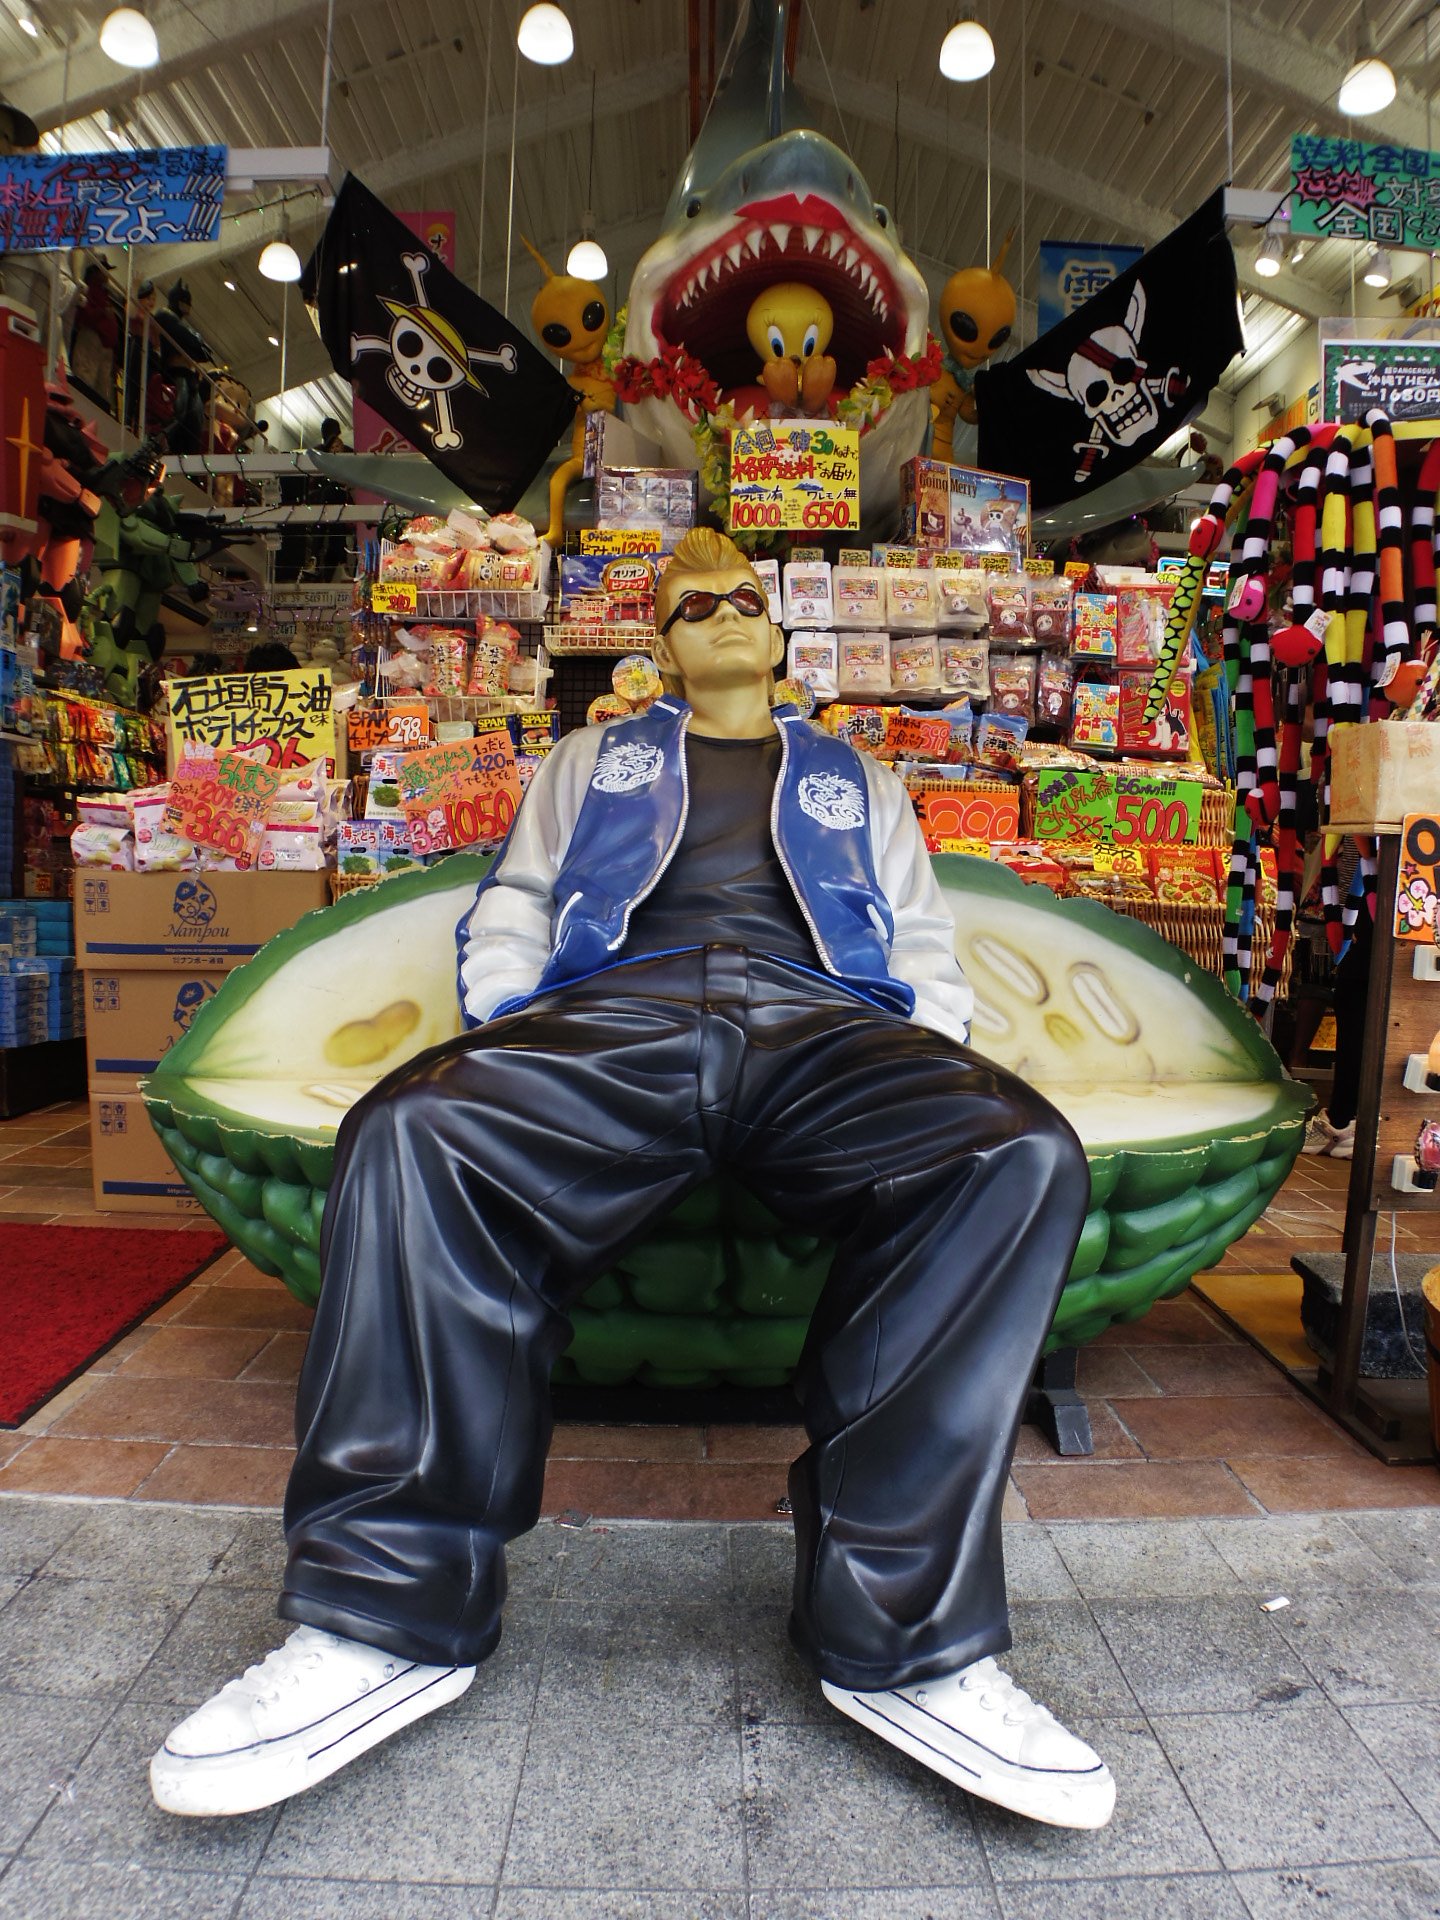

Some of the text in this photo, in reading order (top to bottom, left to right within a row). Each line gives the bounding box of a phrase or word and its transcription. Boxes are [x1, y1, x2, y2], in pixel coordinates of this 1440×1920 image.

[919, 471, 977, 499] Going Merry
[613, 569, 646, 578] オリオン
[611, 580, 646, 590] ビアナッツ
[171, 673, 332, 716] 石垣島ラー油
[175, 710, 329, 748] ポテトチップス 味
[349, 710, 389, 728] SPAM
[478, 717, 507, 729] SPAM
[521, 714, 551, 724] SPAM
[847, 714, 883, 734] 沖縄
[341, 824, 376, 845] 海ぶどう
[384, 824, 411, 846] 海ぶど
[163, 923, 230, 943] Nampou
